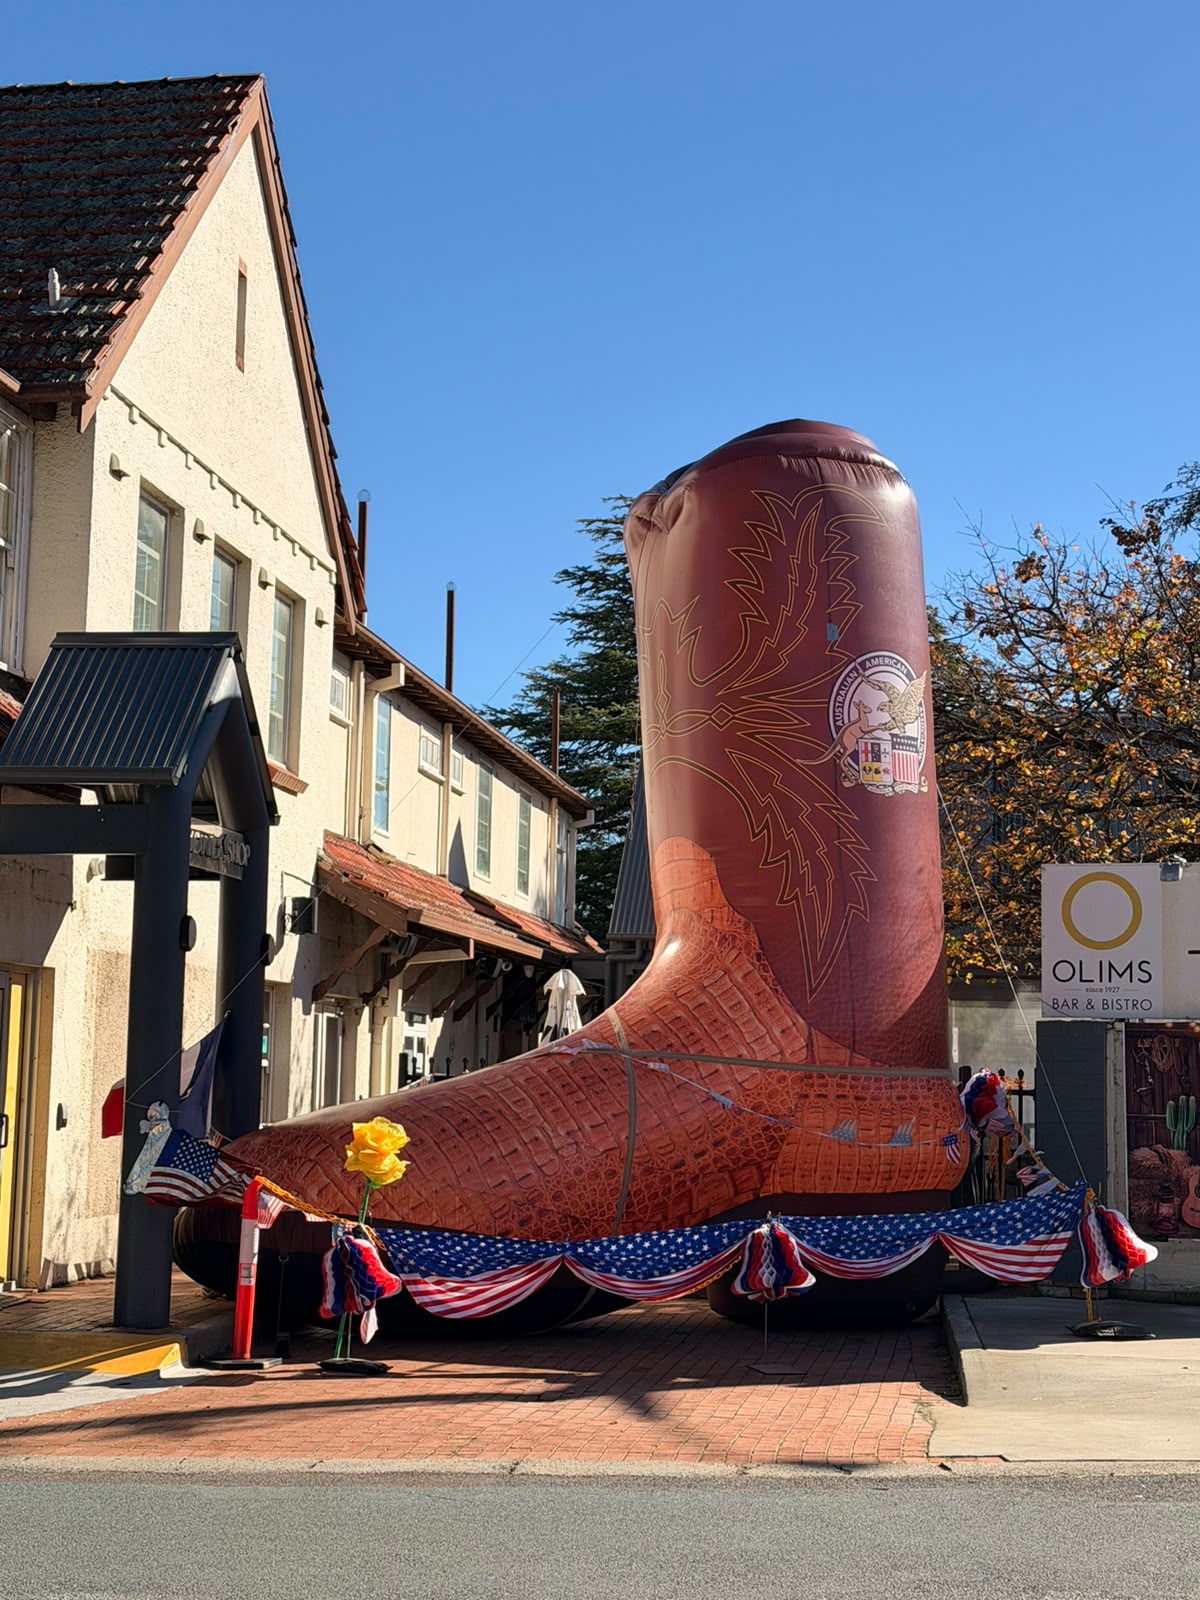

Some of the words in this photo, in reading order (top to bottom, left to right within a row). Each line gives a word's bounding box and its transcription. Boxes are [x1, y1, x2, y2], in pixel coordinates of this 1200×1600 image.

[834, 670, 859, 727] AUSTRALIAN
[865, 657, 908, 675] AMERICAN
[227, 838, 251, 867] SHOP
[1052, 959, 1153, 984] OLIMS
[1085, 986, 1104, 994] since
[1104, 986, 1121, 994] 1927
[1052, 998, 1079, 1011] BAR
[1085, 998, 1096, 1011] &
[1102, 998, 1153, 1011] BISTRO
